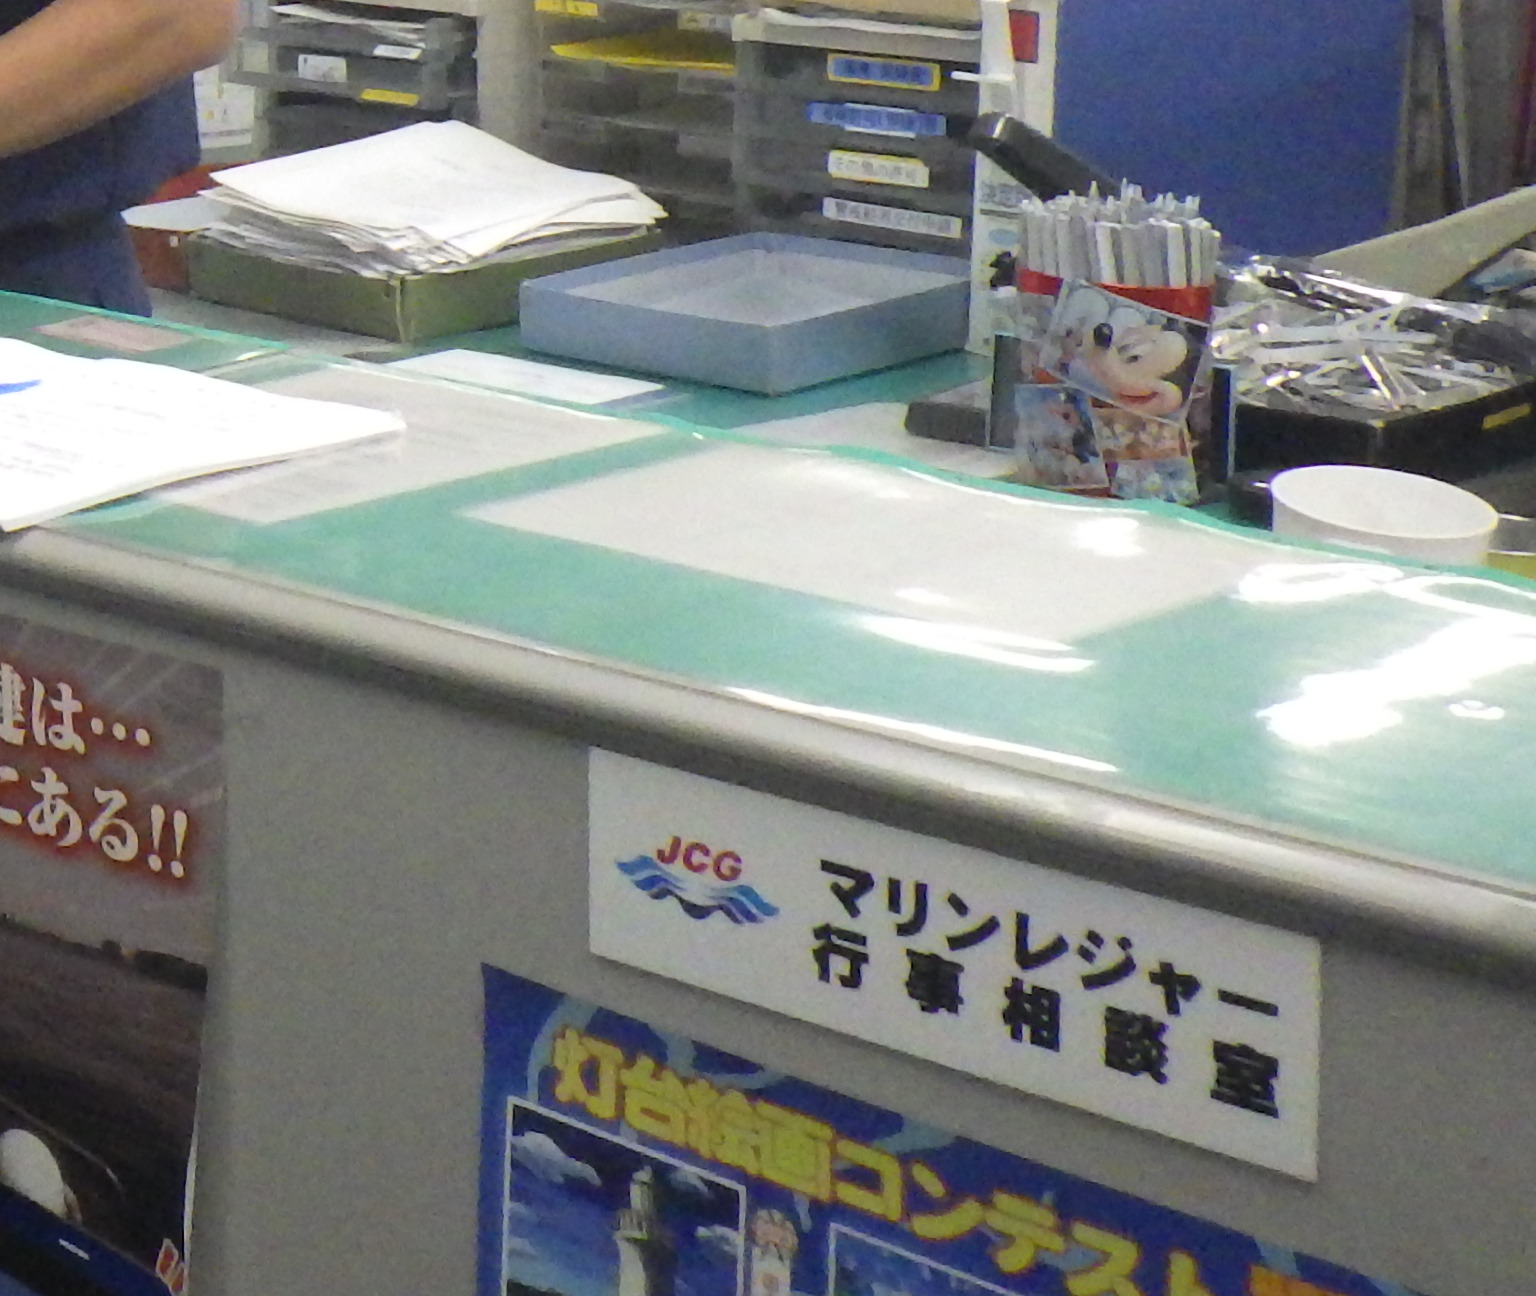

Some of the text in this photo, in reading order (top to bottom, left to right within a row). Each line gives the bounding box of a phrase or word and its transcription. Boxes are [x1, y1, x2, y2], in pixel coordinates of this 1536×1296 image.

[656, 835, 744, 882] JCG
[819, 858, 1280, 1018] マリンレジャー
[812, 923, 1280, 1119] 行事相談室
